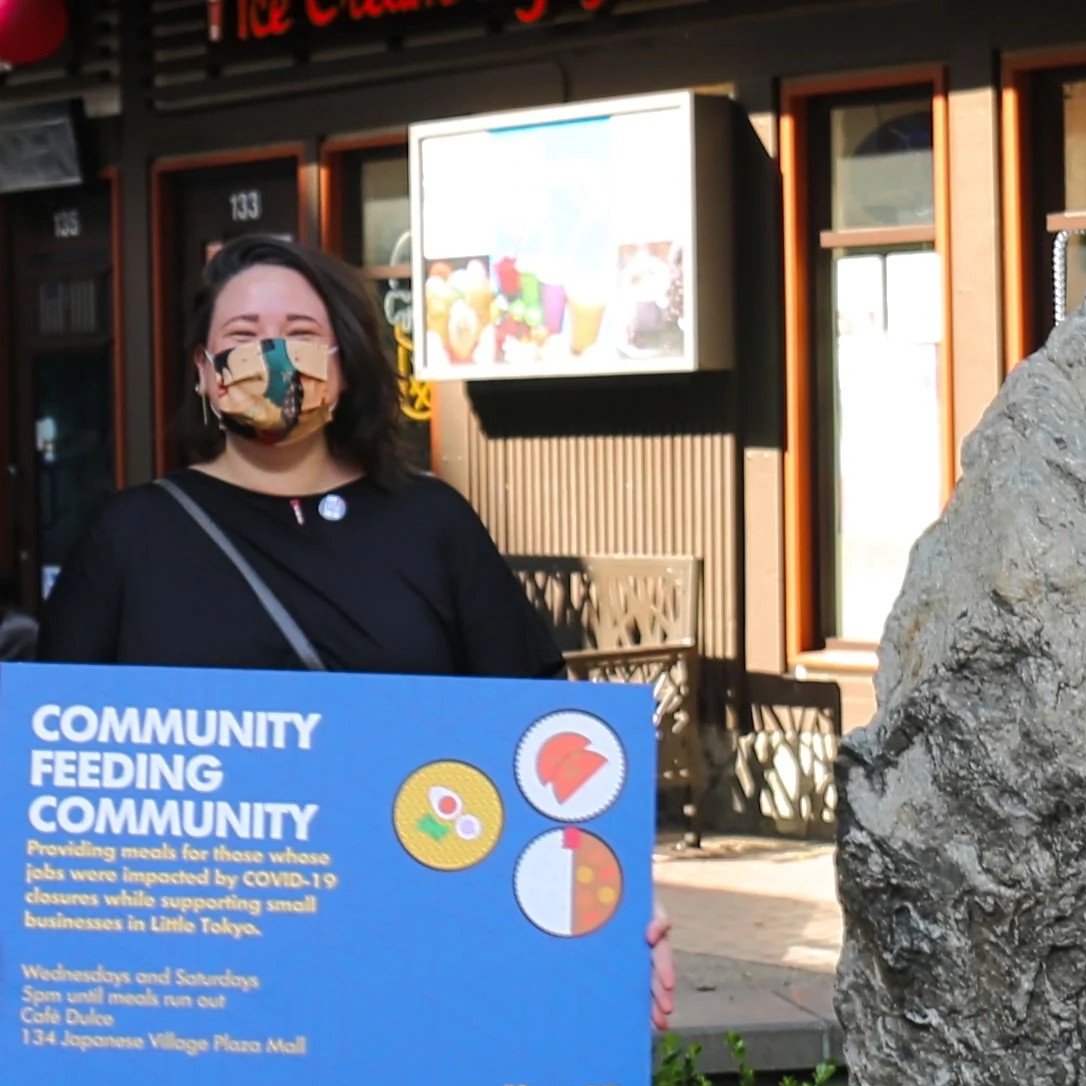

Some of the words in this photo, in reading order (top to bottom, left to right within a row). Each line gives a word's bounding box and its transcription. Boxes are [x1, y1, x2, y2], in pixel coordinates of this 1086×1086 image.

[229, 190, 261, 221] 133
[31, 704, 322, 750] COMMUNITY
[30, 749, 223, 791] FEEDING
[28, 795, 319, 841] COMMUNITY
[27, 839, 116, 863] Providing
[121, 842, 178, 860] meals
[181, 843, 208, 861] for
[213, 845, 264, 863] those
[269, 846, 331, 866] whose
[25, 862, 65, 884] jobs
[70, 868, 117, 882] were
[122, 866, 210, 888] impacted
[214, 869, 238, 890] by
[242, 870, 338, 889] COVID-19
[25, 886, 99, 906] closures
[103, 889, 156, 908] while
[160, 893, 262, 916] supporting
[266, 895, 317, 913] small
[24, 910, 123, 931] businesses
[127, 914, 146, 932] in
[151, 915, 196, 933] Little
[200, 916, 262, 939] Tokyo.
[21, 963, 130, 988] Wednesdays
[135, 967, 171, 985] and
[175, 968, 260, 992] Saturdays
[67, 986, 104, 1004] until
[108, 988, 160, 1007] meals
[163, 995, 192, 1008] run
[196, 994, 226, 1008] out
[65, 1007, 114, 1027] Dulce
[21, 1027, 57, 1046] 134
[60, 1030, 145, 1052] Japanese
[148, 1031, 209, 1056] Village
[212, 1034, 262, 1053] Plaza
[266, 1036, 307, 1054] Mall
